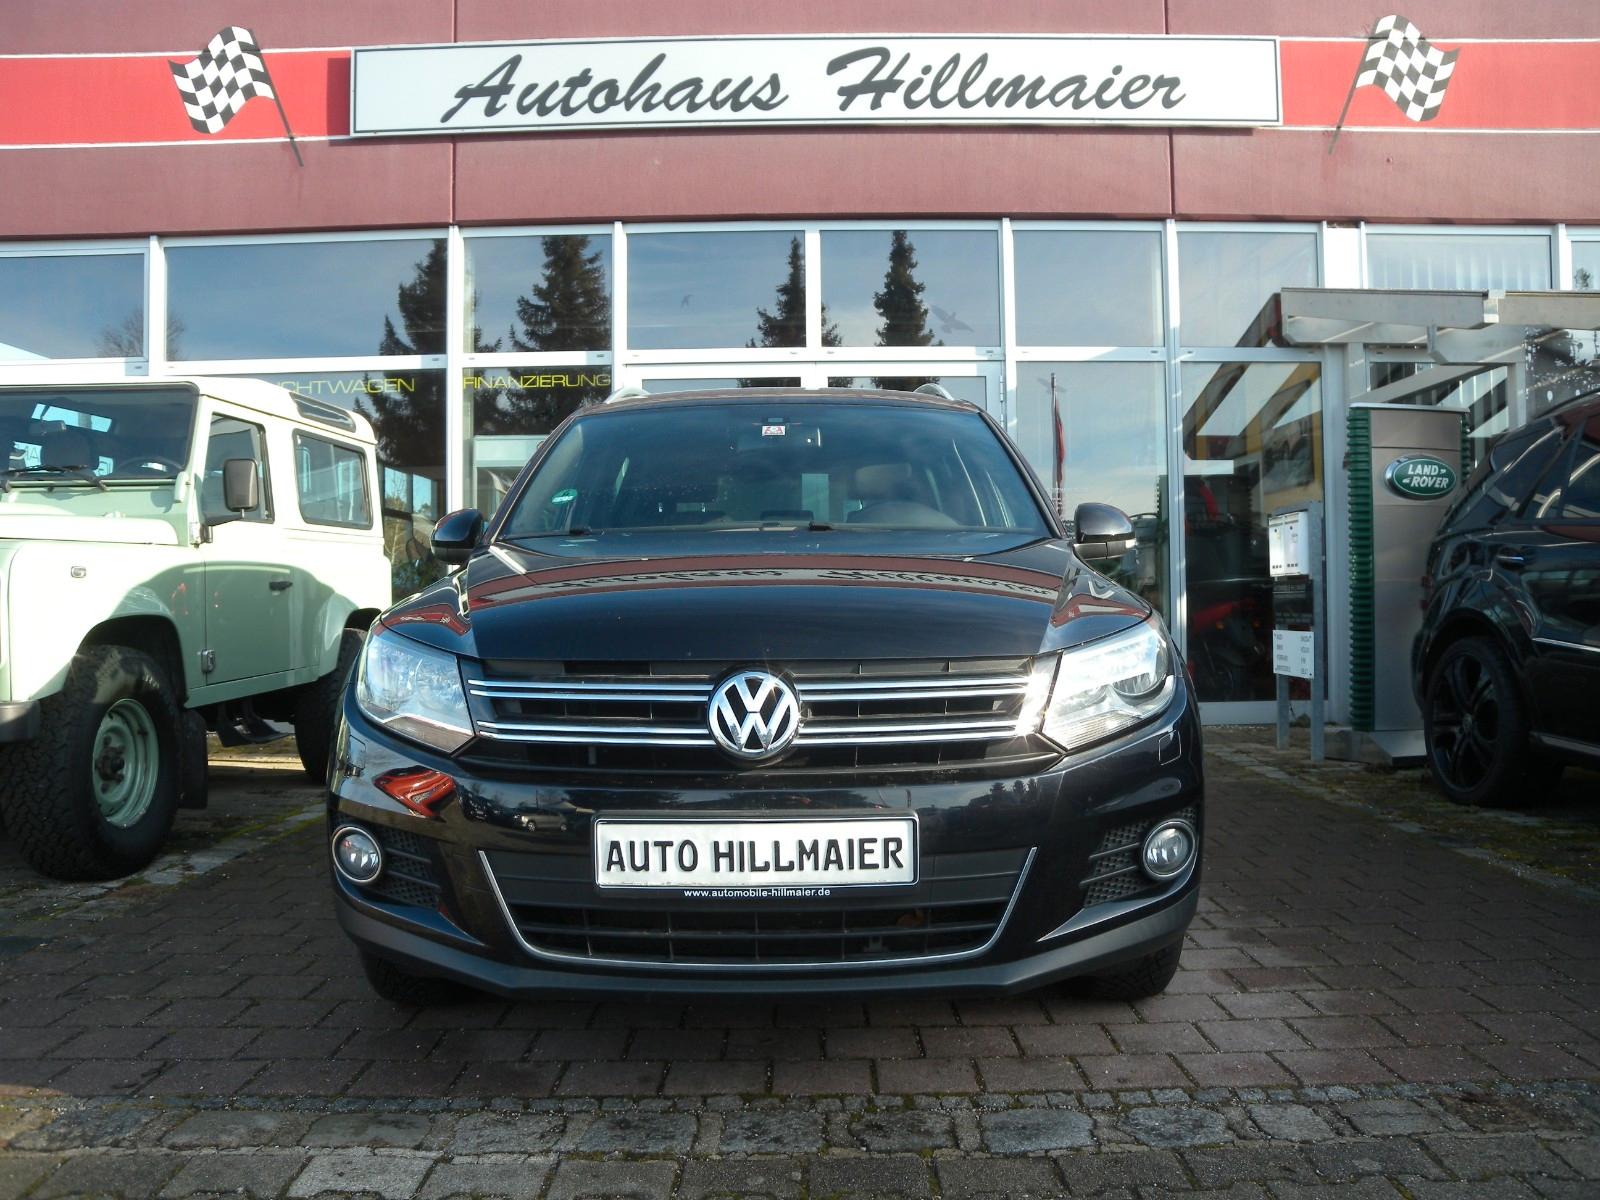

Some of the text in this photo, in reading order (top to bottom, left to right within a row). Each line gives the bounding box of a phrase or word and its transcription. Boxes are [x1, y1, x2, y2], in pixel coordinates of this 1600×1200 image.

[441, 47, 1184, 123] Autohaus Hillmaier
[277, 378, 415, 394] CHTWAGEN
[463, 374, 610, 389] FINANZIERUNG
[1408, 464, 1439, 475] LAND
[1411, 476, 1449, 488] ROVER
[710, 672, 798, 756] VW
[607, 838, 904, 872] AUTO HILLMAIER
[684, 887, 831, 897] www.automobile-hillmaier.de
